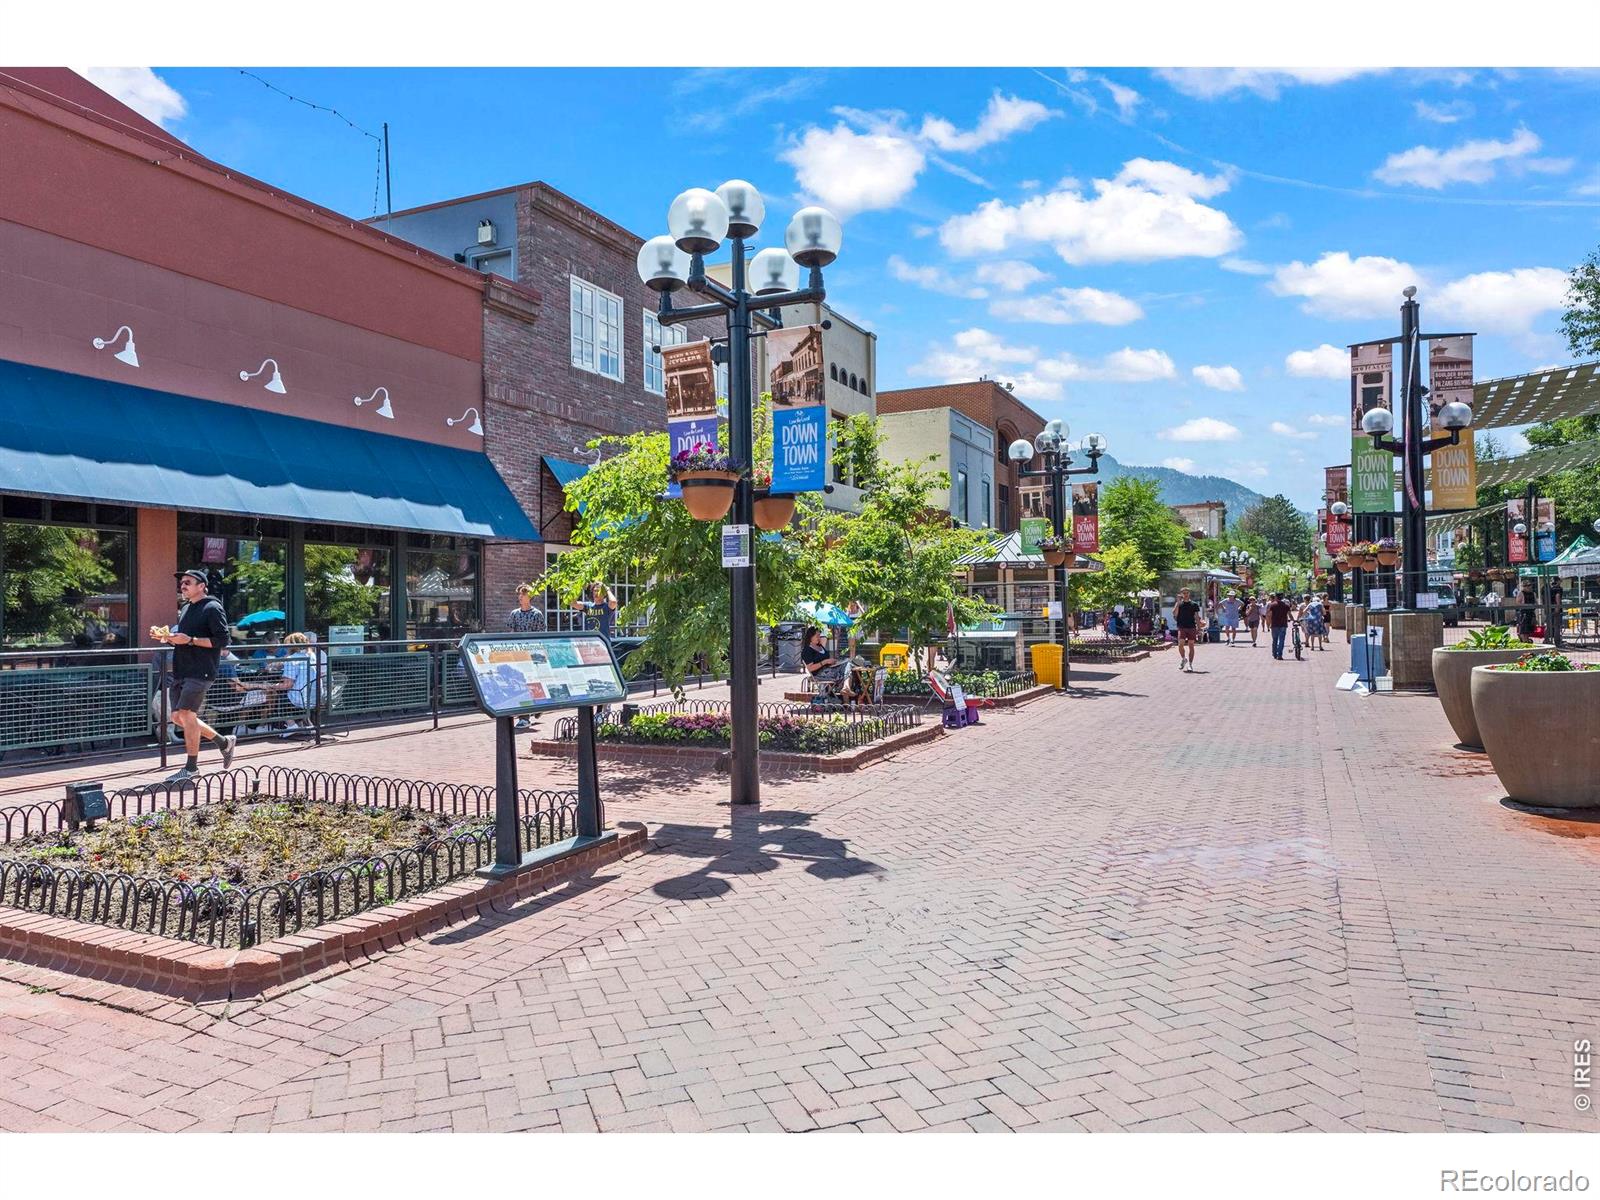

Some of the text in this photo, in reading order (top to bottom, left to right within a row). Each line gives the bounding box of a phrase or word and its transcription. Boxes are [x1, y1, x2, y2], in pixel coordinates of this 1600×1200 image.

[782, 422, 818, 445] DOWN
[782, 444, 818, 466] TOWN
[1357, 454, 1388, 473] DOWN
[1436, 448, 1469, 468] DOWN
[1357, 472, 1388, 491] TOWN
[1436, 468, 1470, 486] TOWN
[1024, 526, 1042, 536] DOWN
[1076, 523, 1095, 532] DOWN
[1328, 524, 1346, 534] DOWN
[1078, 532, 1095, 542] TOWN
[1328, 533, 1346, 544] TOWN
